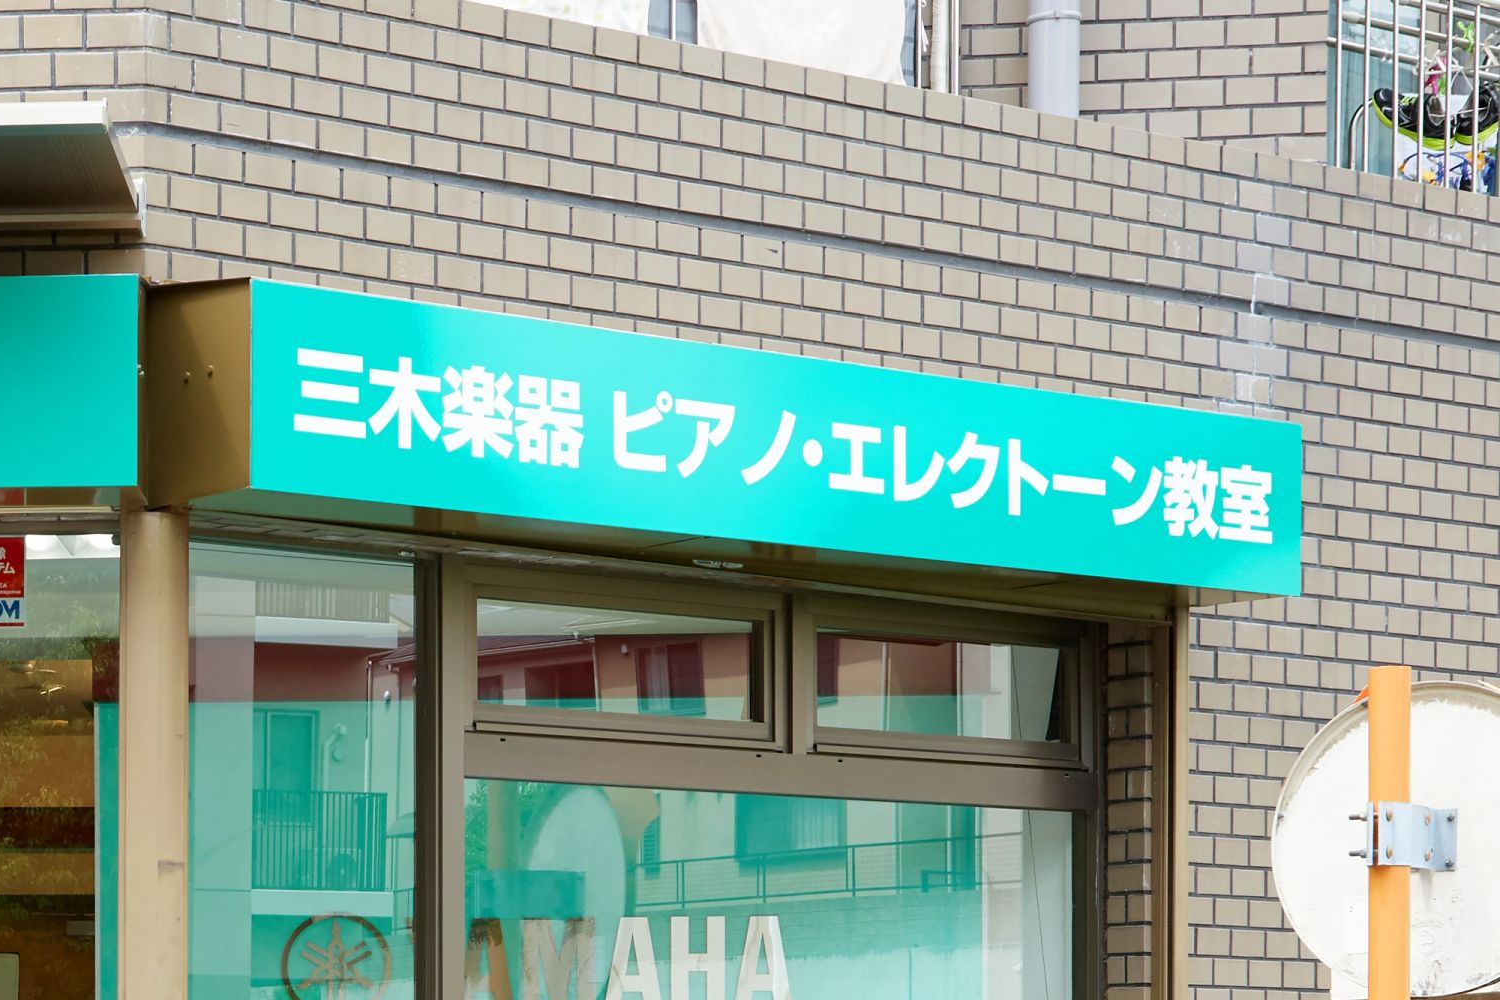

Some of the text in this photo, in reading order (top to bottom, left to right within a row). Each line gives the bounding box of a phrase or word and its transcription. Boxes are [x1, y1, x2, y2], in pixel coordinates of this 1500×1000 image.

[293, 347, 1273, 544] 三木楽器 ピアノ・エレクトーン教室
